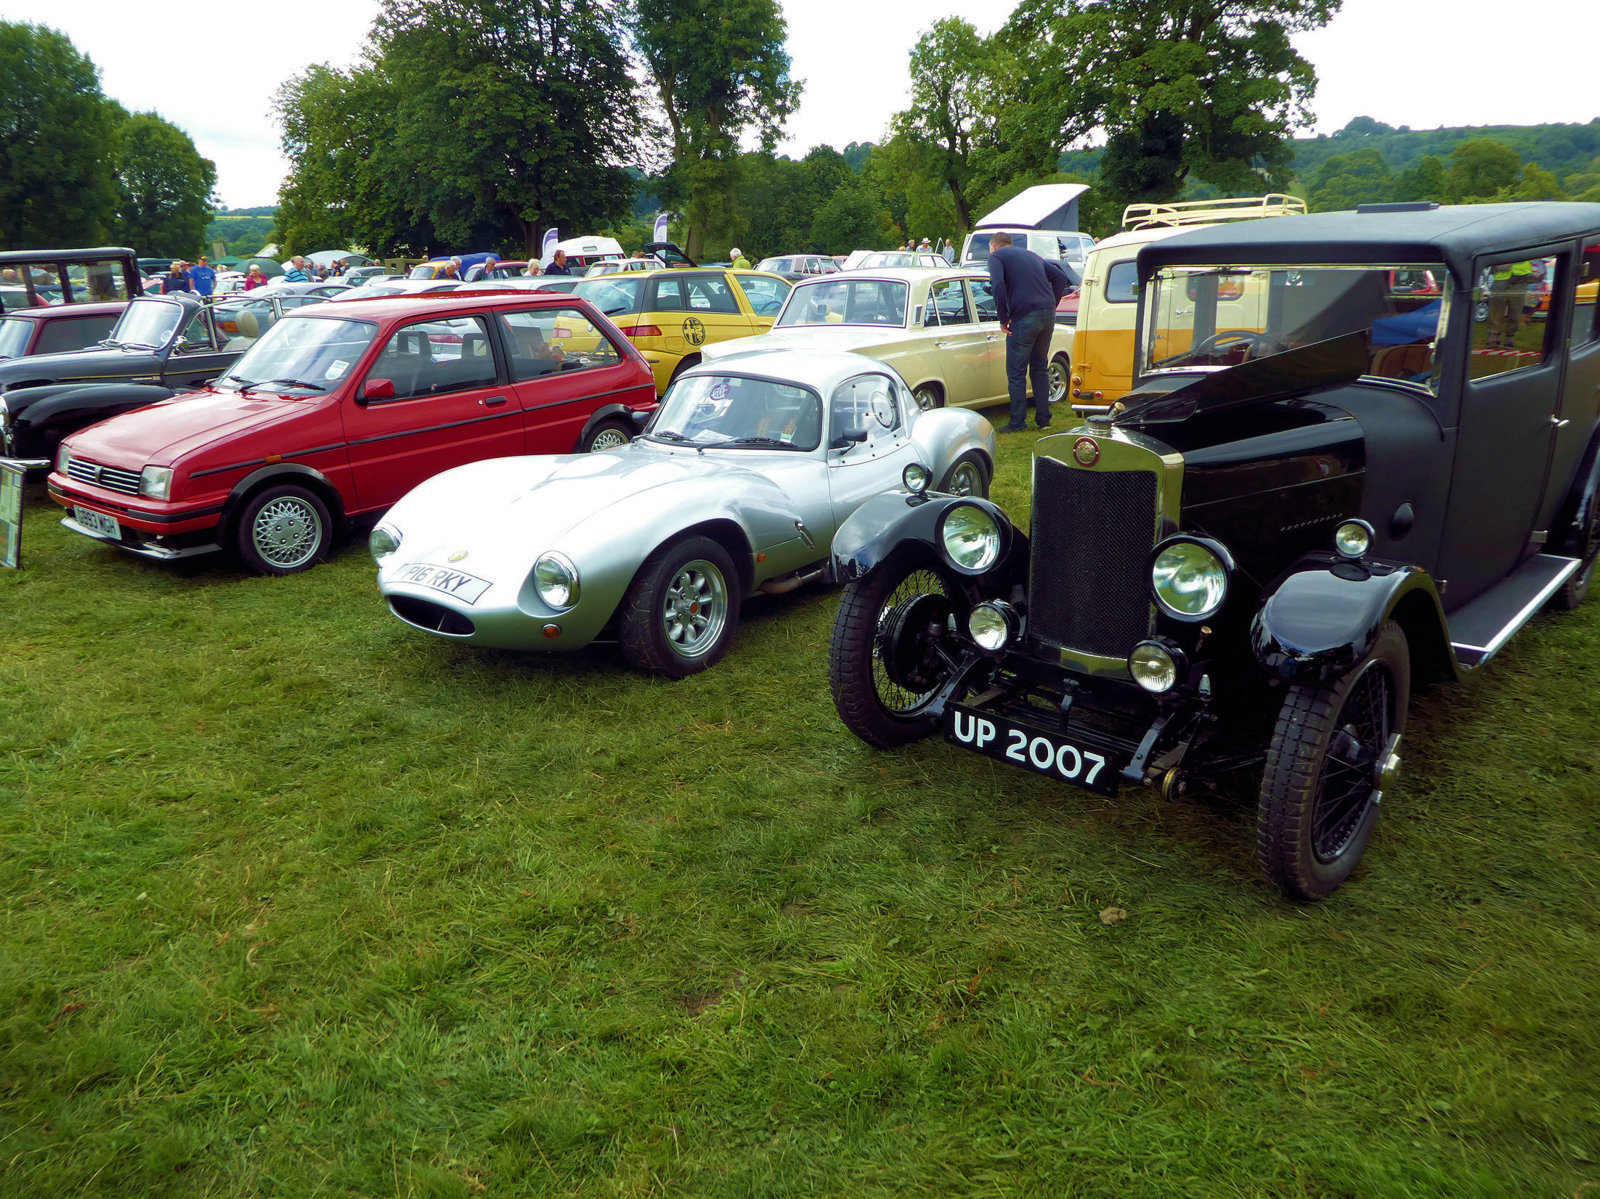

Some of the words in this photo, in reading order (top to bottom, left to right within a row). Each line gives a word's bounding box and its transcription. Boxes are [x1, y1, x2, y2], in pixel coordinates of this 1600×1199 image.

[401, 566, 434, 581] P16
[427, 570, 472, 592] RKY
[954, 711, 996, 748] UP
[1005, 729, 1106, 785] 2007
